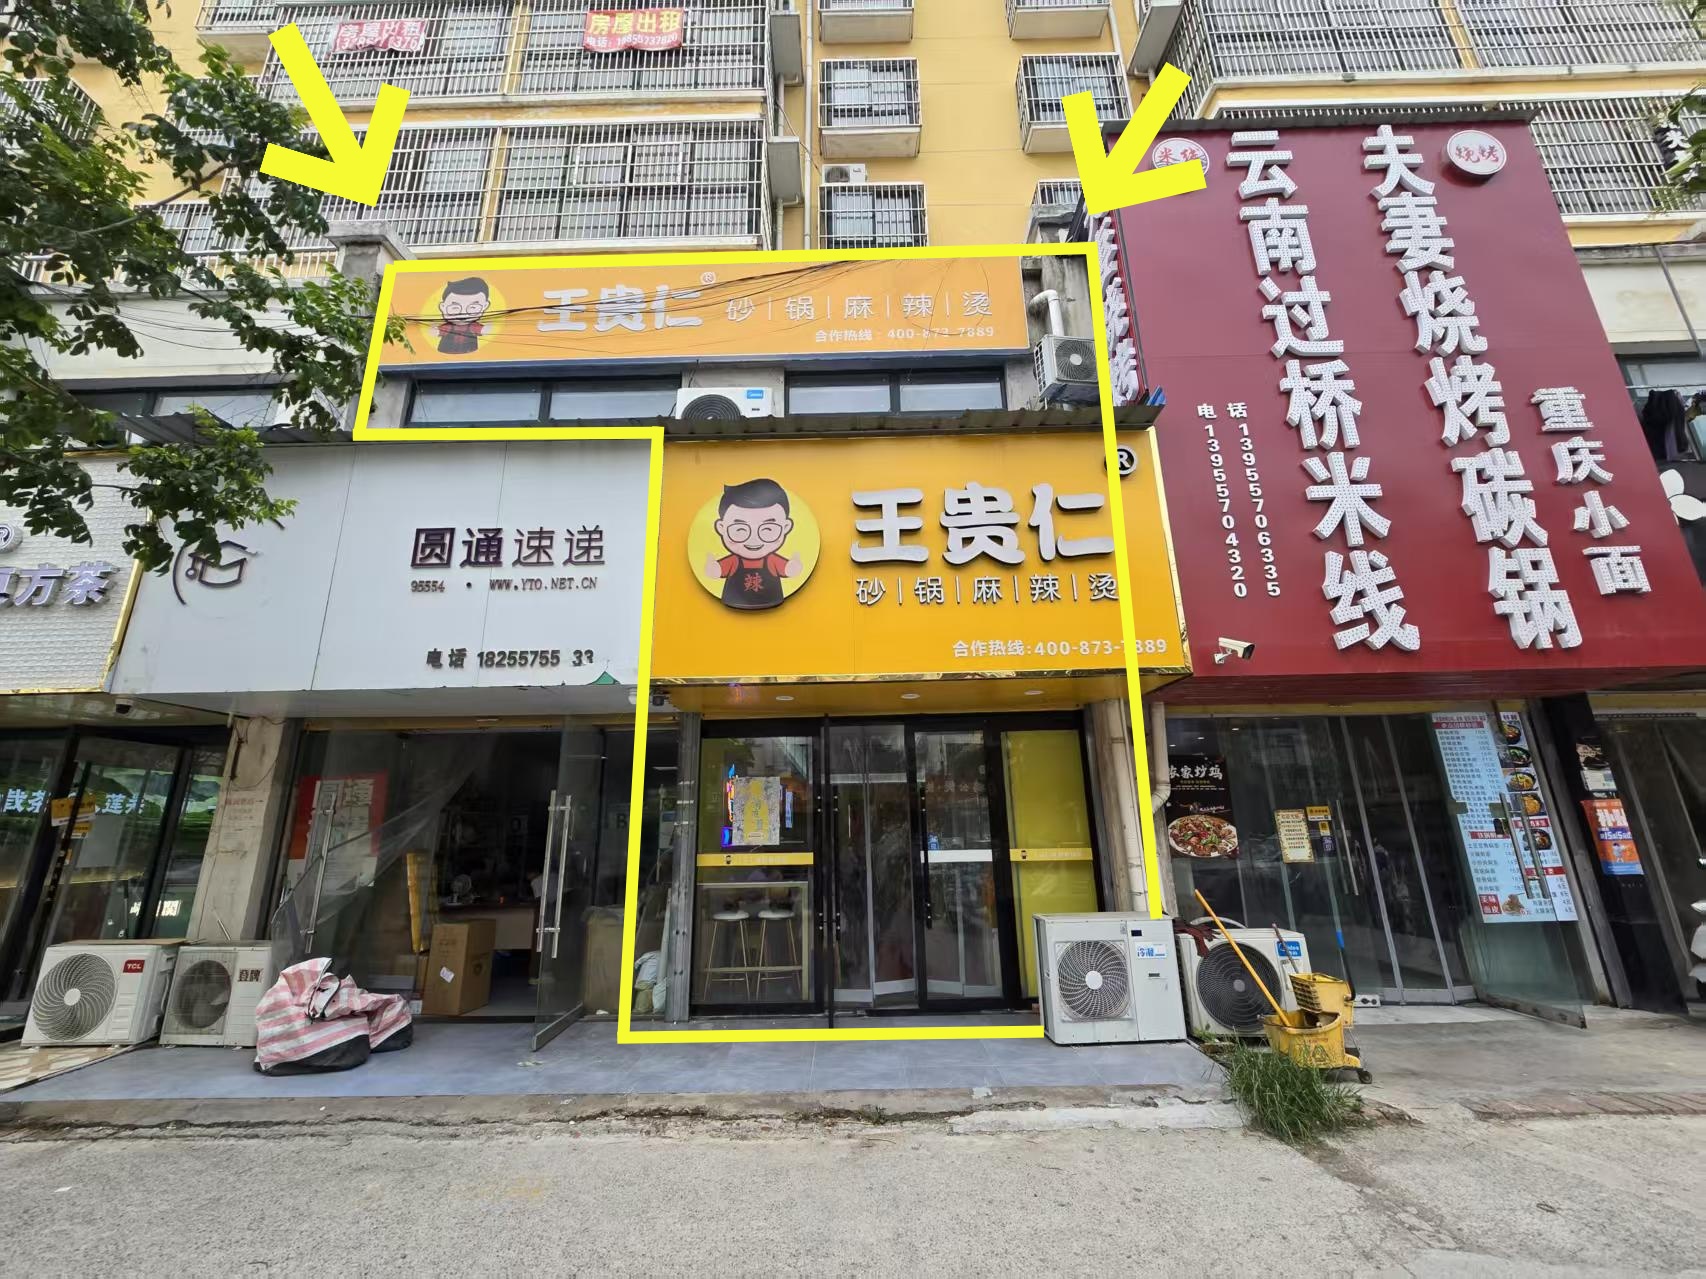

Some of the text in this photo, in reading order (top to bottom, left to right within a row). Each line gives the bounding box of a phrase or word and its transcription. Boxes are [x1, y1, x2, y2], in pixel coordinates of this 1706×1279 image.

[589, 11, 681, 34] 房屋出租
[537, 284, 704, 332] 王贵仁
[1226, 130, 1420, 652] 云南过桥米线
[1363, 124, 1583, 650] 夫妻烧烤碳锅
[411, 525, 606, 568] 圆通速递
[850, 481, 1116, 566] 王贵仁
[1203, 423, 1249, 598] 13955704320
[1238, 423, 1281, 597] 13955706335
[1531, 385, 1652, 596] 重庆小面
[410, 576, 598, 593] 95554 WWW.YTO.NET.CN
